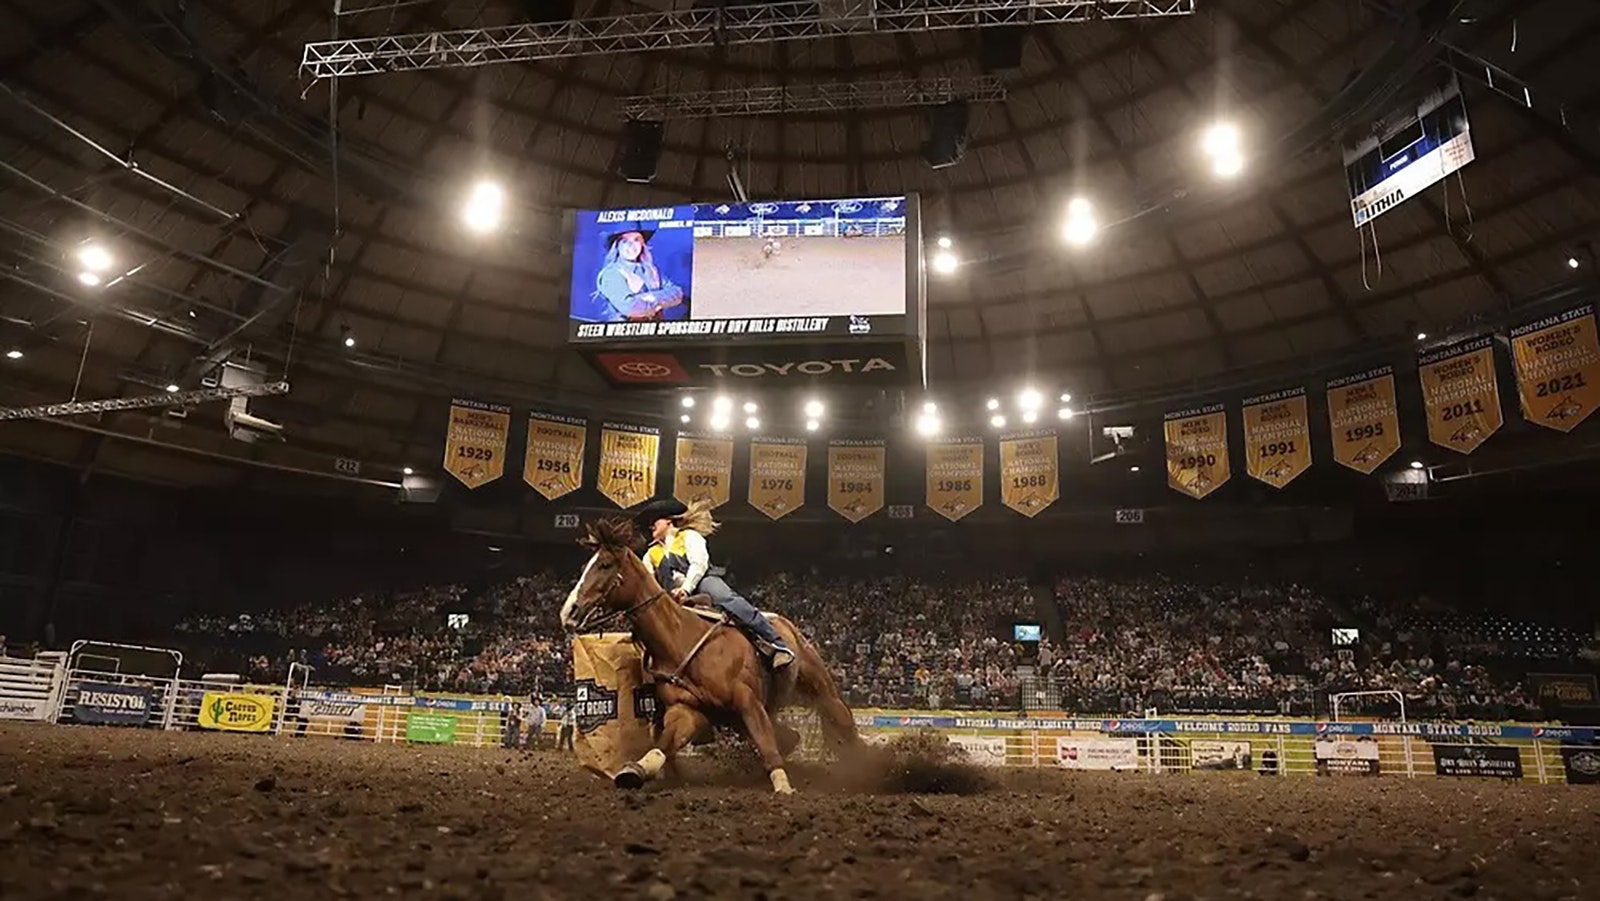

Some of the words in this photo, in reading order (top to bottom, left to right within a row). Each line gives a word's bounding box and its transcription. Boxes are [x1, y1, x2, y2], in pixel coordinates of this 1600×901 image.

[1366, 189, 1404, 218] LITHIA
[597, 210, 626, 223] ALEXIS
[606, 322, 656, 336] WRESTLING
[657, 321, 712, 334] SPONSORED
[712, 320, 727, 333] BY
[727, 320, 748, 333] DRY
[748, 319, 775, 332] HILLS
[775, 317, 829, 331] DISTILLERY
[1510, 316, 1560, 336] MONTANA
[1561, 305, 1593, 321] STATE
[1527, 325, 1580, 347] WOMEN'S
[1419, 347, 1462, 365] MONTANA
[1464, 339, 1491, 351] STATE
[1536, 337, 1575, 354] RODEO
[1523, 346, 1590, 371] NATIONAL
[699, 357, 896, 377] TOYOTA
[1440, 366, 1474, 381] RODEO
[1327, 373, 1367, 388] MONTANA
[1368, 366, 1393, 378] STATE
[1430, 375, 1486, 395] NATIONAL
[1536, 372, 1587, 398] 2021
[1243, 393, 1280, 405] MONTANA
[1282, 387, 1306, 396] STATE
[1426, 383, 1495, 406] CHAMPIONS
[452, 398, 488, 410] MONTANA
[490, 403, 511, 413] STATE
[1164, 409, 1201, 419] MONTANA
[1202, 404, 1225, 413] STATE
[1337, 400, 1387, 418] NATIONAL
[1443, 401, 1483, 421] 2011
[530, 412, 565, 422] MONTANA
[566, 417, 587, 426] STATE
[1333, 408, 1395, 428] CHAMPIONS
[455, 426, 500, 439] NATIONAL
[603, 422, 638, 431] MONTANA
[640, 426, 660, 434] STATE
[1252, 420, 1301, 434] NATIONAL
[1346, 422, 1383, 442] 1995
[1248, 428, 1306, 443] CHAMPIONS
[458, 446, 493, 461] 1929
[1260, 441, 1297, 458] 1991
[537, 459, 570, 473] 1956
[1180, 454, 1216, 470] 1990
[612, 468, 644, 482] 1972
[687, 475, 718, 487] 1975
[1013, 475, 1046, 488] 1988
[761, 480, 793, 490] 1976
[840, 481, 872, 493] 1984
[938, 480, 971, 492] 1986
[79, 690, 146, 709] RESISTOL
[955, 718, 995, 728] NATIONAL
[998, 719, 1073, 730] INTERCOLLEGIATE
[1121, 722, 1145, 732] pepsi
[1175, 721, 1225, 732] WELCOME
[1228, 722, 1260, 732] RODEO
[1264, 723, 1291, 733] FANS
[1328, 725, 1354, 733] pepsi
[1373, 723, 1421, 734] MONTANA
[1427, 724, 1462, 735] STATE
[1468, 725, 1503, 736] RODEO
[1545, 729, 1571, 738] pepsi
